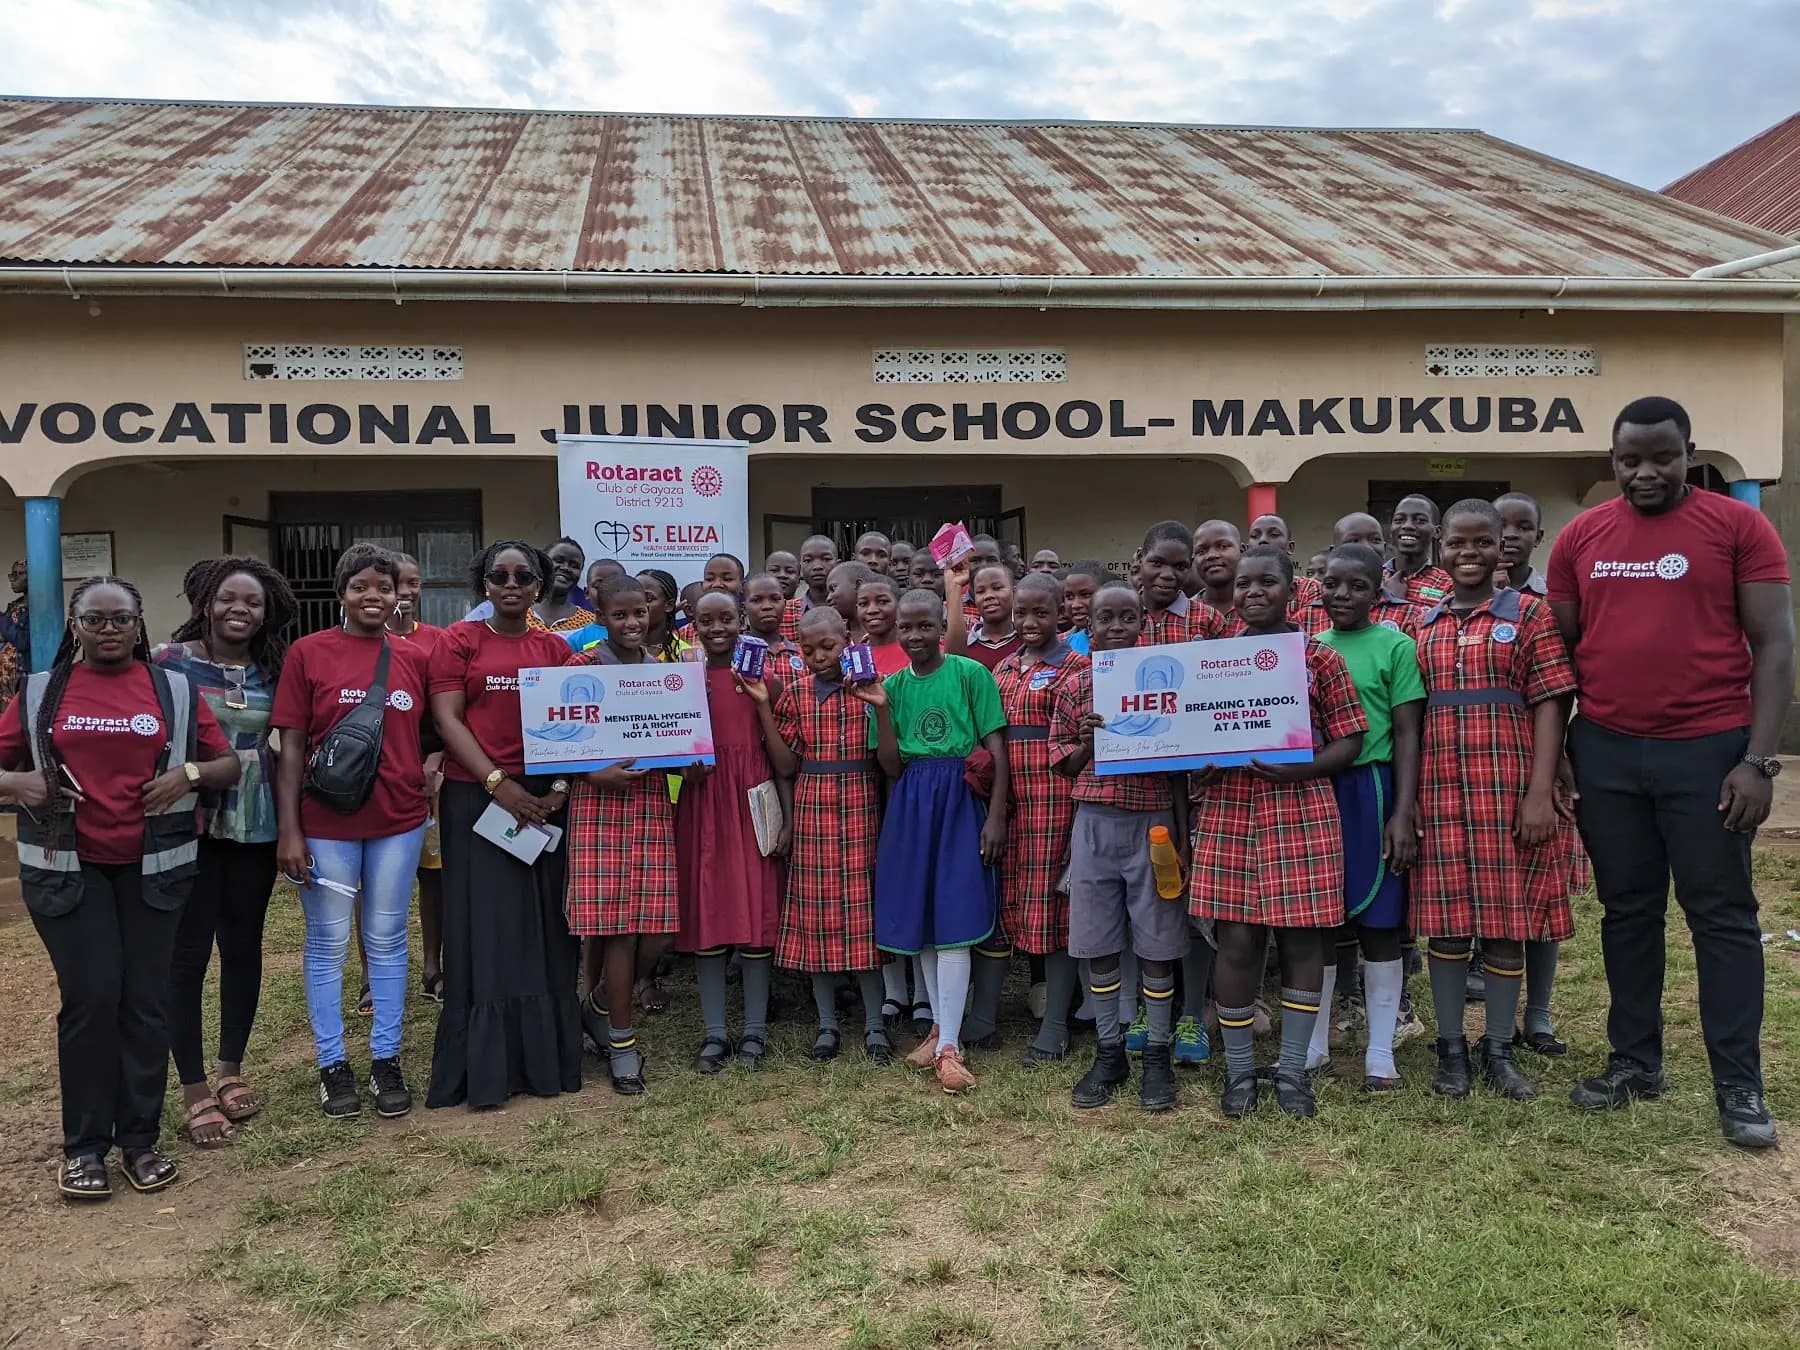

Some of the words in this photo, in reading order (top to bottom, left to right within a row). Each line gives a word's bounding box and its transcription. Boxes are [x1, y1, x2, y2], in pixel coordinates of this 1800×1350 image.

[0, 402, 516, 444] VOCATIONAL
[540, 403, 831, 444] JUNIOR
[1192, 397, 1584, 436] MAKUKUBA
[586, 461, 683, 482] Rotaract
[596, 482, 622, 493] Club
[626, 483, 639, 493] of
[640, 483, 684, 496] Gayaza
[616, 496, 650, 507] District
[655, 497, 684, 508] 9213
[632, 524, 659, 543] ST.
[667, 525, 718, 543] ELIZA
[1107, 562, 1119, 571] OF
[1594, 561, 1655, 570] Rotaract
[1590, 571, 1608, 579] Club
[1200, 657, 1252, 669] Rotaract
[1196, 672, 1214, 680] Club
[1215, 671, 1223, 679] of
[1224, 670, 1252, 679] Gayaza
[619, 679, 662, 688] Rotaract
[639, 689, 663, 697] Gayaza
[1121, 691, 1178, 712] HER
[1185, 699, 1245, 712] BREAKING
[1248, 696, 1299, 708] TABOOS,
[548, 704, 600, 722] HER
[605, 713, 659, 723] MENSTRUAL
[661, 712, 702, 721] HYGIENE
[1213, 711, 1239, 720] ONE
[1242, 709, 1267, 718] PAD
[67, 715, 129, 726] Rotaract
[651, 721, 678, 729] RIGHT
[1214, 723, 1229, 732] AT
[1231, 722, 1241, 730] A
[1245, 720, 1271, 730] TIME
[622, 731, 644, 739] NOT
[645, 730, 652, 738] A
[656, 728, 692, 737] LUXURY
